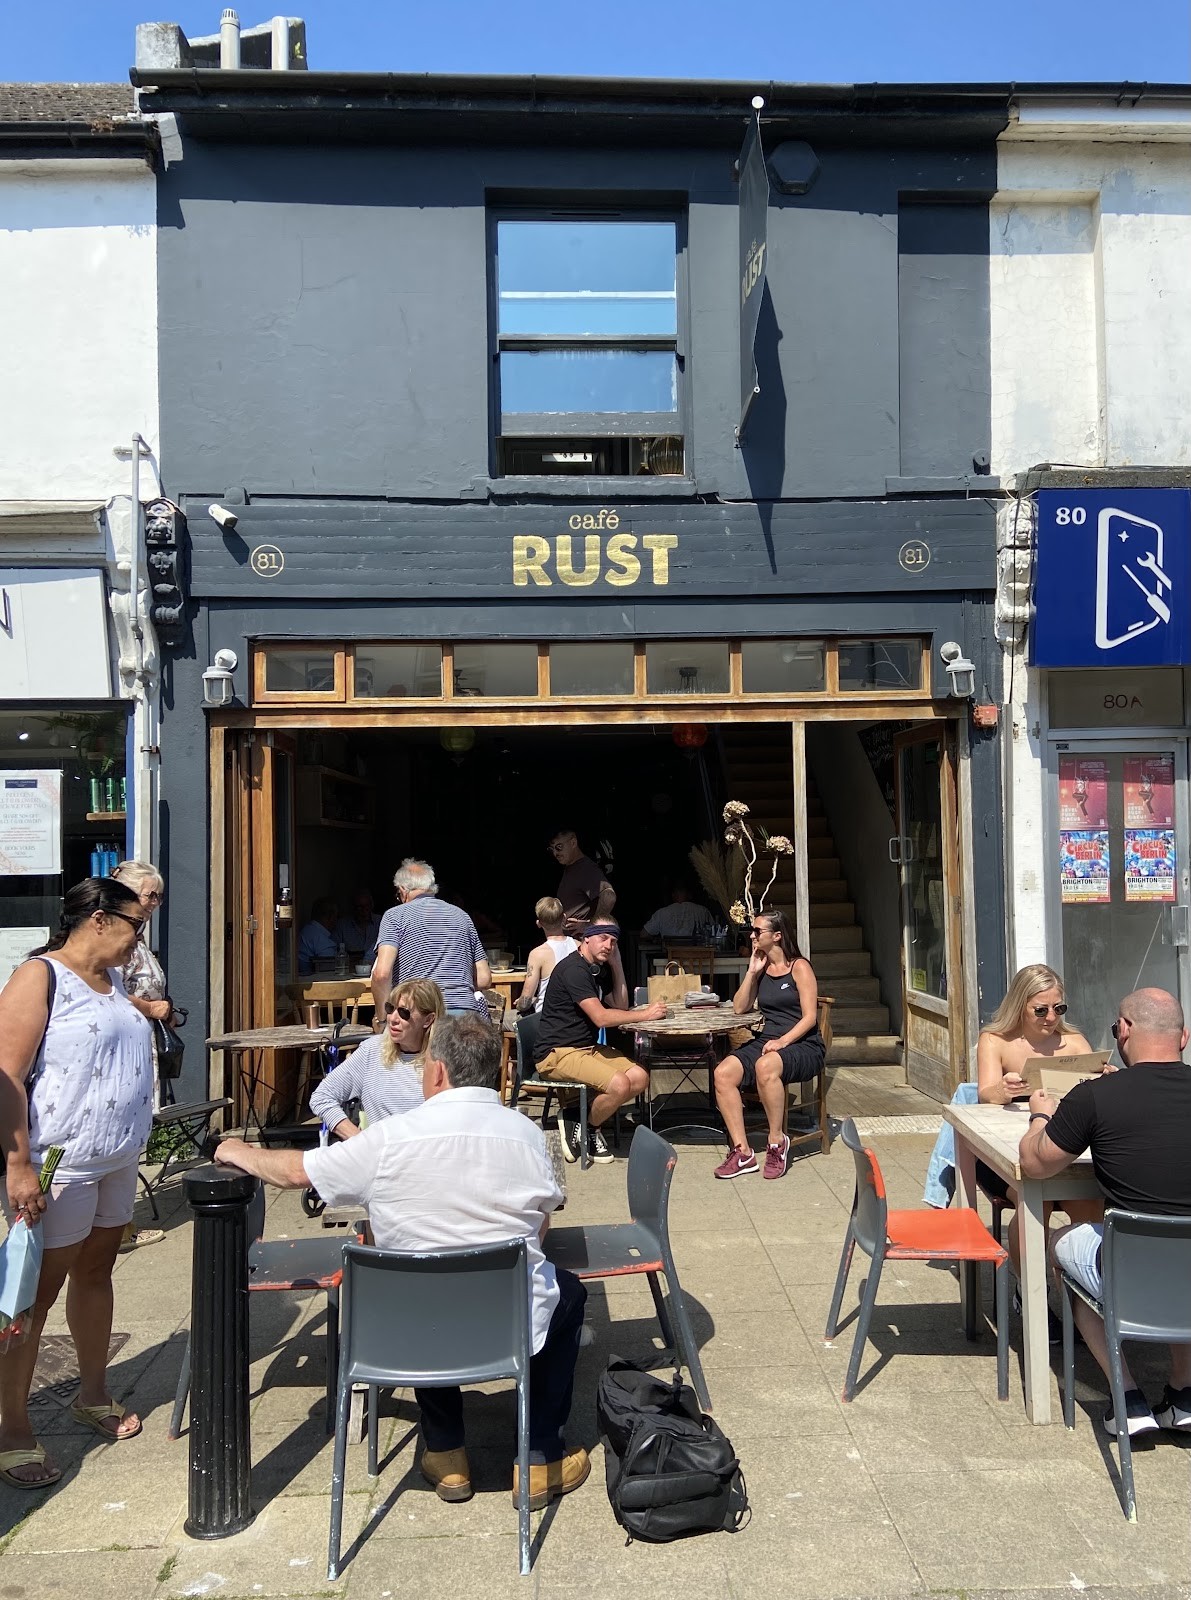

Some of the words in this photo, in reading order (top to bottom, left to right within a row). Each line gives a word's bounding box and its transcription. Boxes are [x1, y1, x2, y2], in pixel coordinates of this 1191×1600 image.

[568, 509, 620, 530] café
[1055, 507, 1087, 525] 80
[257, 553, 279, 569] 81
[512, 533, 679, 587] RUST
[905, 548, 925, 564] 81
[1066, 840, 1099, 855] CIRCUS
[1075, 849, 1102, 861] BERLIN
[1132, 840, 1164, 854] CIRCUS
[1140, 848, 1168, 859] BERLIN
